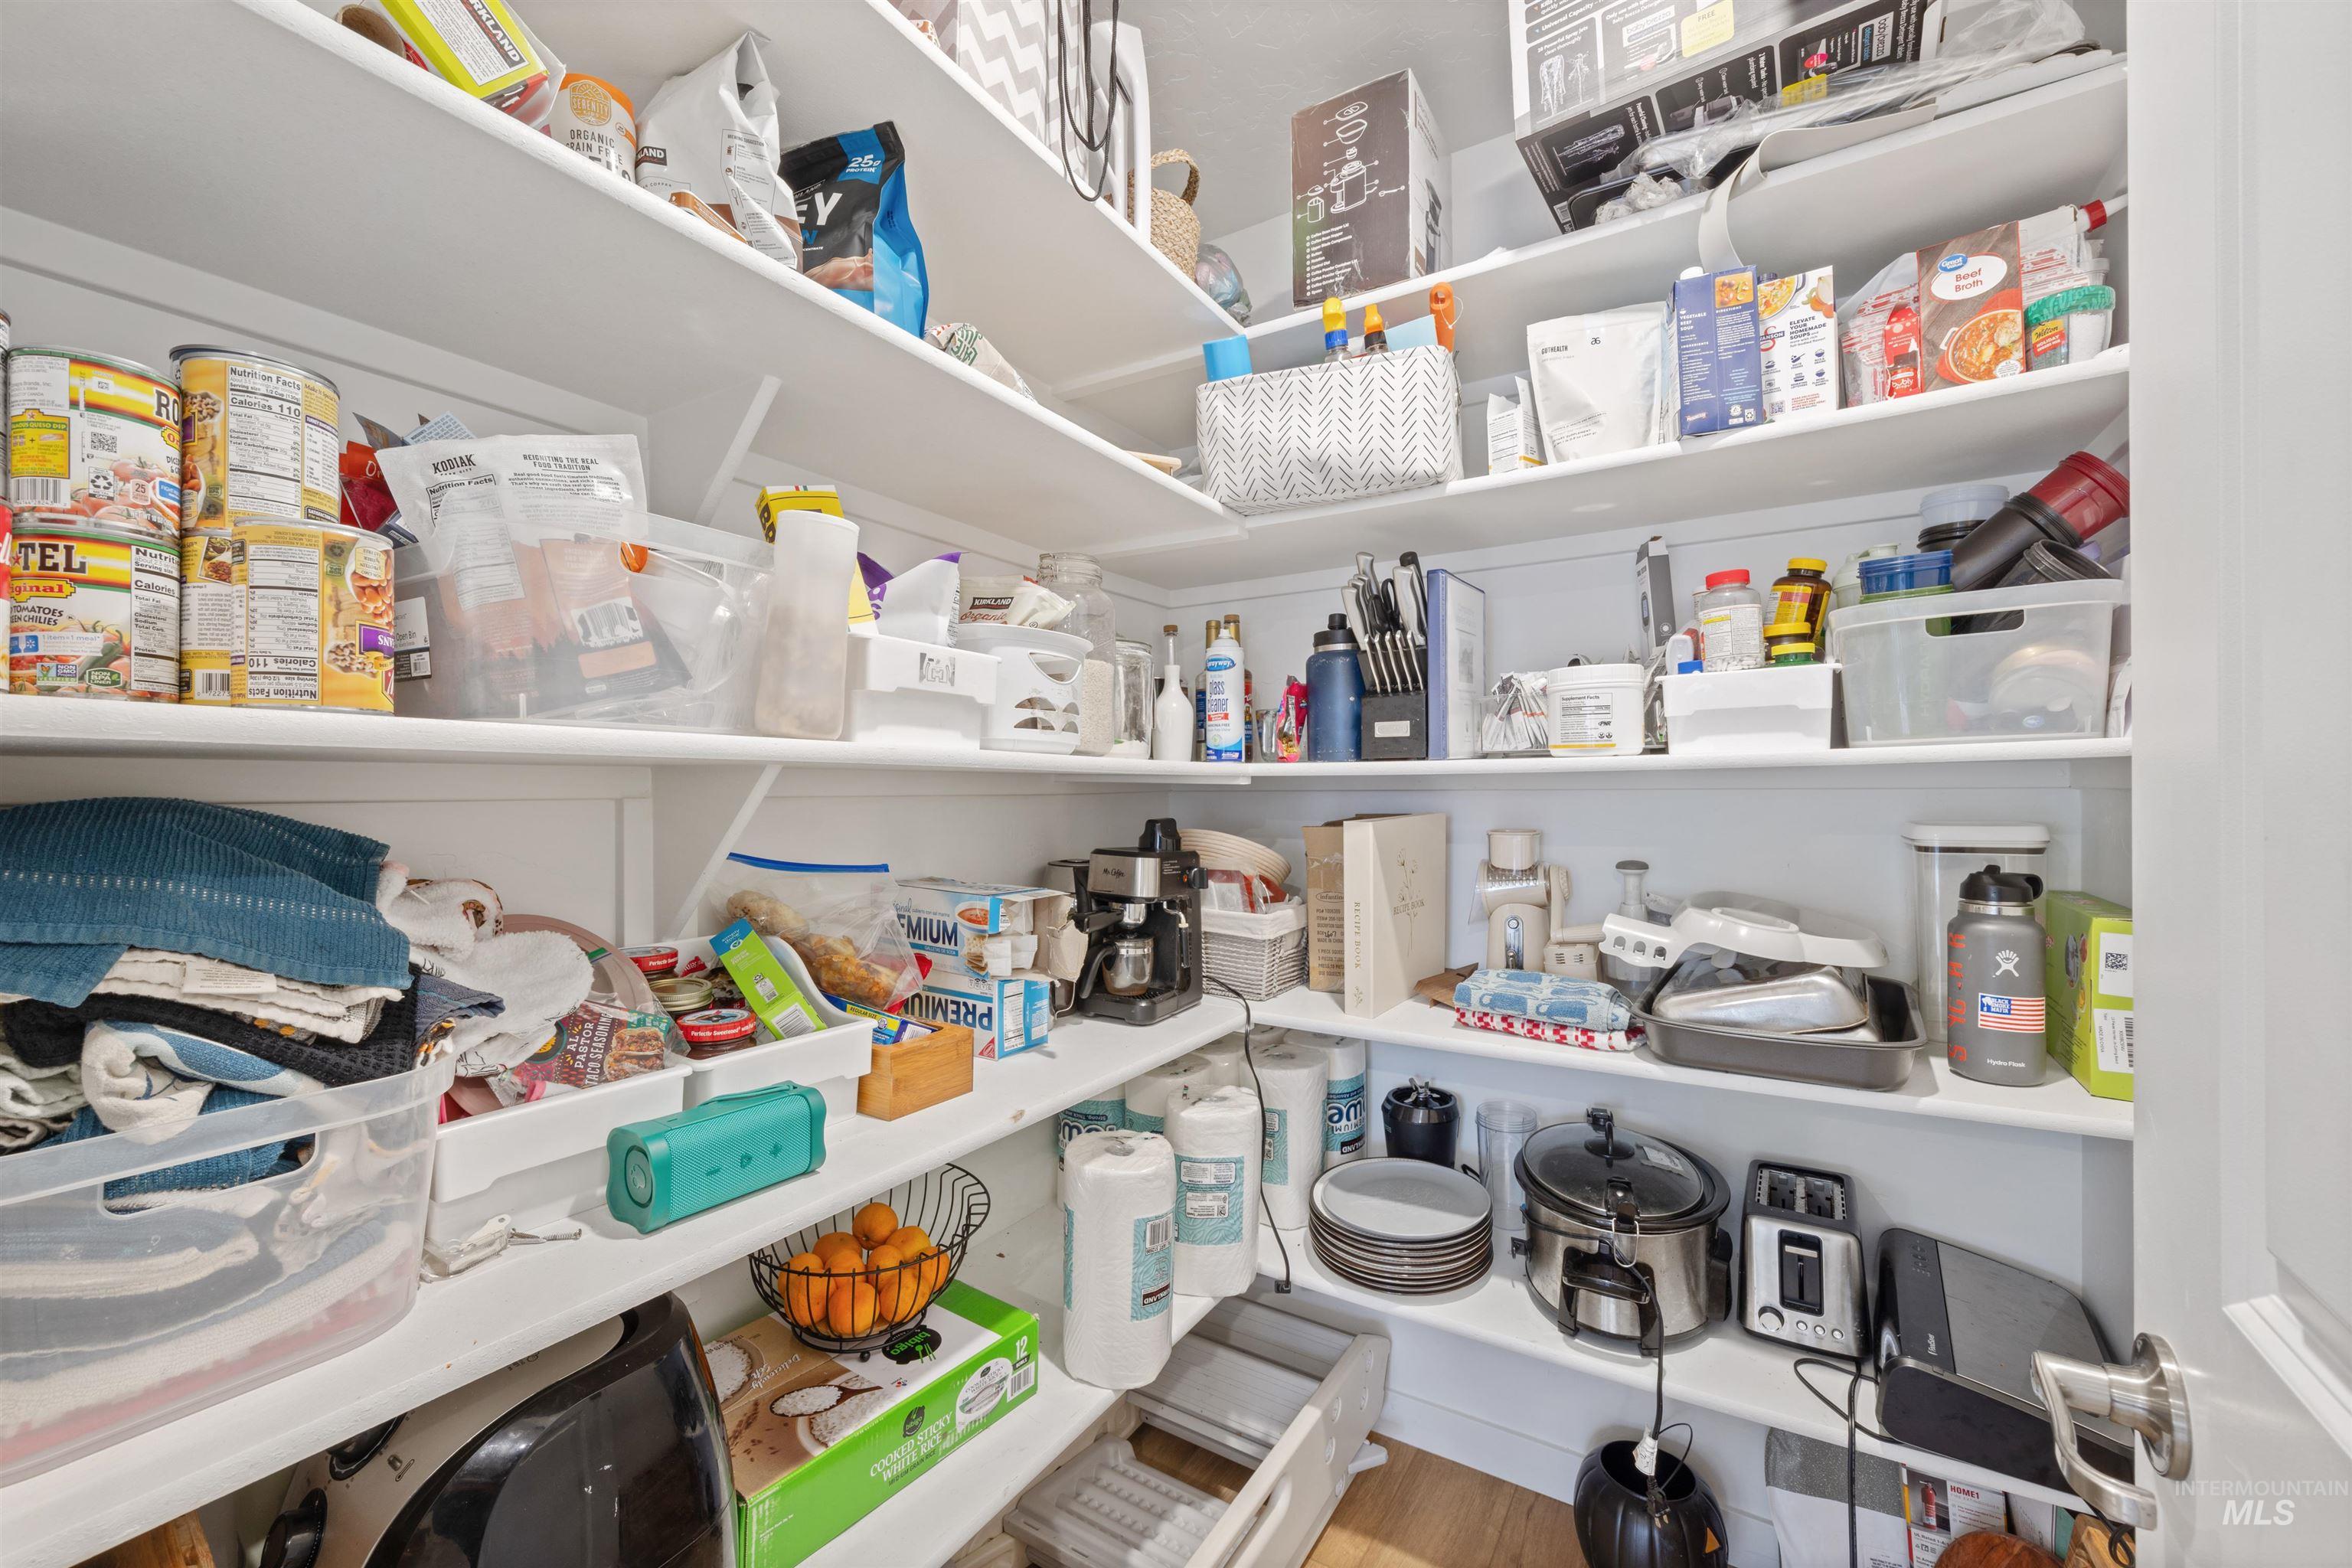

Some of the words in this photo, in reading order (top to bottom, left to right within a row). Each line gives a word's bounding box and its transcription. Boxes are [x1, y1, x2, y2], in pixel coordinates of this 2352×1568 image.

[1541, 13, 1569, 31] Universal
[1570, 4, 1594, 22] Capacity
[1697, 9, 1716, 23] FREE
[1543, 38, 1564, 52] Powerful
[1557, 35, 1583, 51] thoroughly
[572, 97, 609, 116] SERENITY
[570, 129, 615, 149] ORGANIC
[598, 145, 623, 165] FRE
[847, 154, 880, 168] 25g
[1941, 256, 1963, 267] Great
[1955, 267, 1982, 283] Beef
[1955, 279, 1983, 292] Broth
[1680, 312, 1707, 320] VEGETABLE
[1716, 305, 1742, 314] DIRECTIONS
[1789, 315, 1816, 326] ELEVATE
[1789, 322, 1808, 331] YOUR
[1789, 322, 1827, 335] HOMEMADE
[2034, 325, 2058, 340] Wilton
[1789, 332, 1811, 341] SOUPS
[2037, 334, 2060, 348] HOLIDAY
[1541, 345, 1568, 354] GUTHEALTH
[230, 367, 273, 383] Nutrition
[276, 376, 301, 391] Facts
[231, 397, 273, 411] Calories
[278, 403, 301, 418] 110
[230, 429, 259, 437] Cholesterol
[243, 442, 279, 452] Carbohydrate
[431, 453, 476, 475] KODIAK
[522, 454, 564, 464] REIGNITING
[553, 462, 591, 471] TRADITION
[135, 482, 145, 494] 25
[429, 480, 465, 495] Nutrition
[468, 476, 493, 486] Facts
[18, 542, 88, 574] TEL
[135, 560, 162, 572] Serving
[135, 579, 175, 595] Calories
[12, 605, 64, 618] TOMATOES
[960, 610, 1008, 622] Organic
[23, 614, 58, 626] CHILIES
[396, 632, 407, 642] Open
[408, 631, 416, 639] Bin
[248, 658, 268, 668] 110
[273, 657, 317, 668] Calories
[248, 687, 270, 697] Facts
[274, 688, 317, 700] Nutrition
[1210, 680, 1224, 697] glass
[1111, 868, 1125, 879] Coffee
[1393, 901, 1410, 916] RECIPE
[1410, 899, 1426, 910] BOOK
[849, 1006, 868, 1016] REGULAR
[567, 1035, 580, 1052] AL
[590, 1012, 613, 1061] SEASONING
[574, 1022, 594, 1069] PASTOR
[1987, 1058, 2007, 1067] Hydro
[584, 1062, 602, 1085] TACO
[890, 1330, 932, 1356] bibigo
[1016, 1335, 1028, 1361] 12
[750, 1363, 771, 1380] Soft
[751, 1353, 801, 1390] Deliciously
[905, 1416, 923, 1431] bibigo
[870, 1439, 915, 1477] COOKED
[917, 1411, 953, 1446] STICKY
[882, 1453, 918, 1482] WHITE
[921, 1432, 942, 1456] RICE
[910, 1457, 924, 1472] GRAIN
[924, 1449, 936, 1462] RICE
[1950, 1485, 1980, 1500] HOME1
